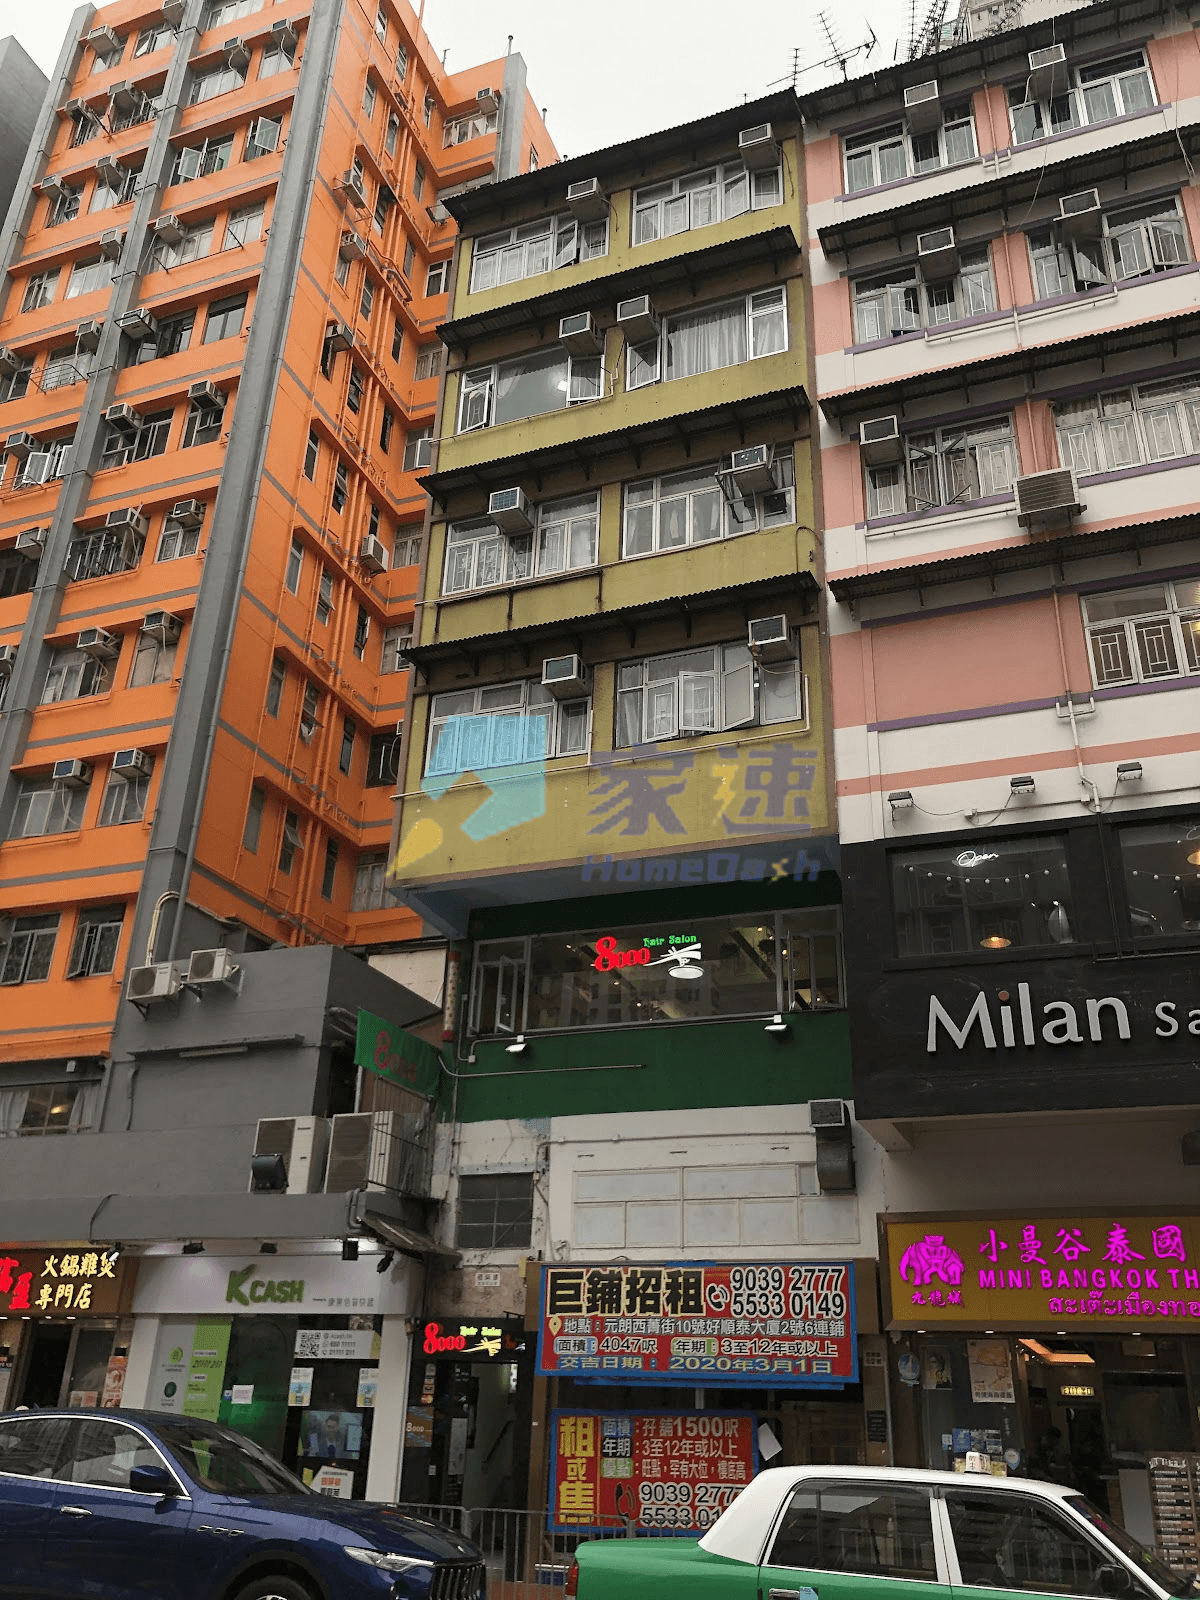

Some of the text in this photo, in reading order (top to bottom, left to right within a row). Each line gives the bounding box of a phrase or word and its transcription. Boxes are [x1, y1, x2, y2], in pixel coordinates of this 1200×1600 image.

[956, 850, 999, 867] Open
[669, 934, 697, 944] Salon
[594, 936, 650, 971] 8000
[927, 982, 1131, 1052] Milan
[979, 1223, 1187, 1265] 小曼谷泰國
[731, 1267, 844, 1292] 9039 2777
[979, 1268, 1200, 1289] MINI BANGKOK TH
[35, 1283, 92, 1310] 專門店
[548, 1268, 706, 1317] 巨鋪招租
[731, 1292, 845, 1317] 5533 0149
[423, 1322, 466, 1354] 8000
[640, 1484, 691, 1504] 9039
[641, 1507, 691, 1526] 5533
